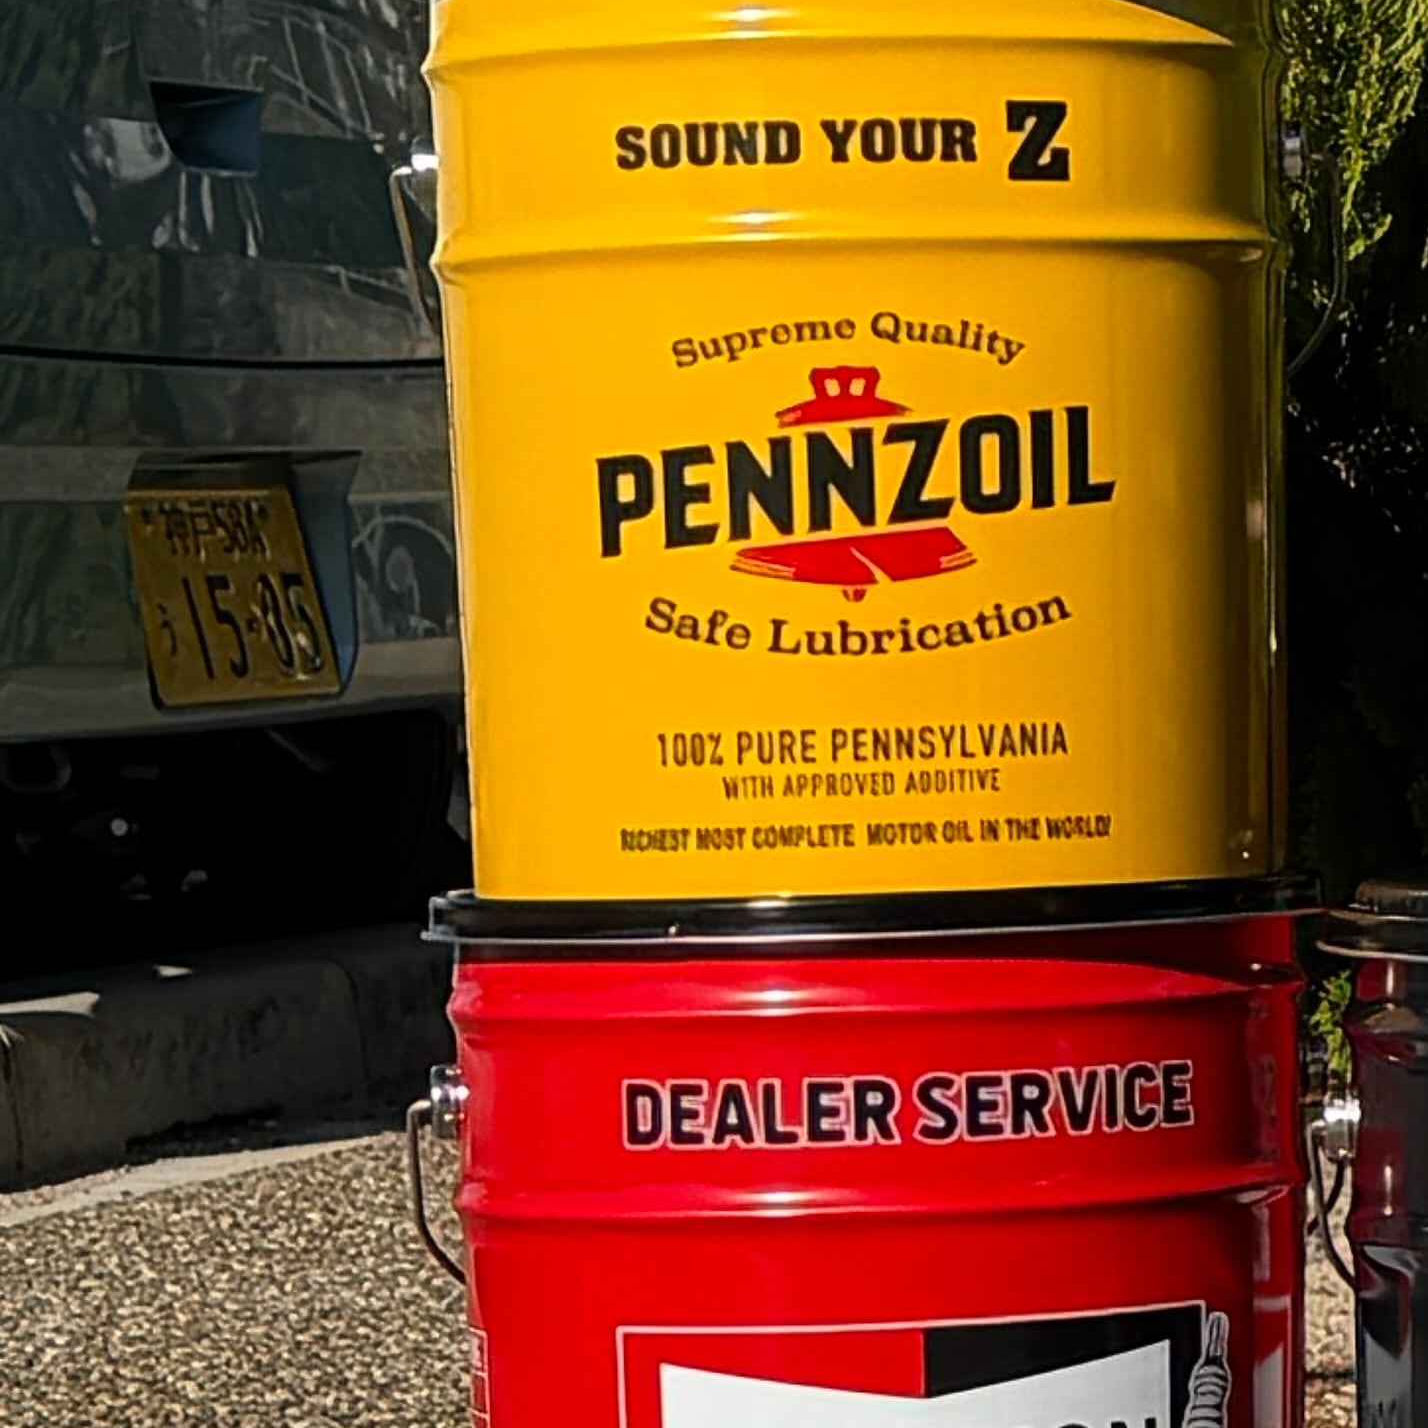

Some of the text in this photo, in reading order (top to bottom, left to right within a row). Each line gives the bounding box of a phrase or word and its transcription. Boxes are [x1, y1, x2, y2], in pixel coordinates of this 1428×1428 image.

[615, 100, 1070, 181] SOUND YOUR Z
[671, 311, 1026, 368] Supreme Quality
[595, 405, 1116, 558] PENNZOIL
[645, 594, 1073, 656] Safe Lubrication
[657, 721, 1069, 767] 100% PURE PENNSYLVANIA
[721, 767, 1002, 801] WITH APPROVED ADDITIVE
[620, 826, 690, 853] RICHEST
[695, 823, 747, 851] MOST
[751, 822, 856, 850] COMPLETE
[866, 820, 937, 848] MOTOR
[941, 819, 975, 844] OIL
[980, 818, 1000, 842] IN
[1005, 816, 1041, 842] THE
[621, 1059, 1195, 1150] DEALER SERVICE
